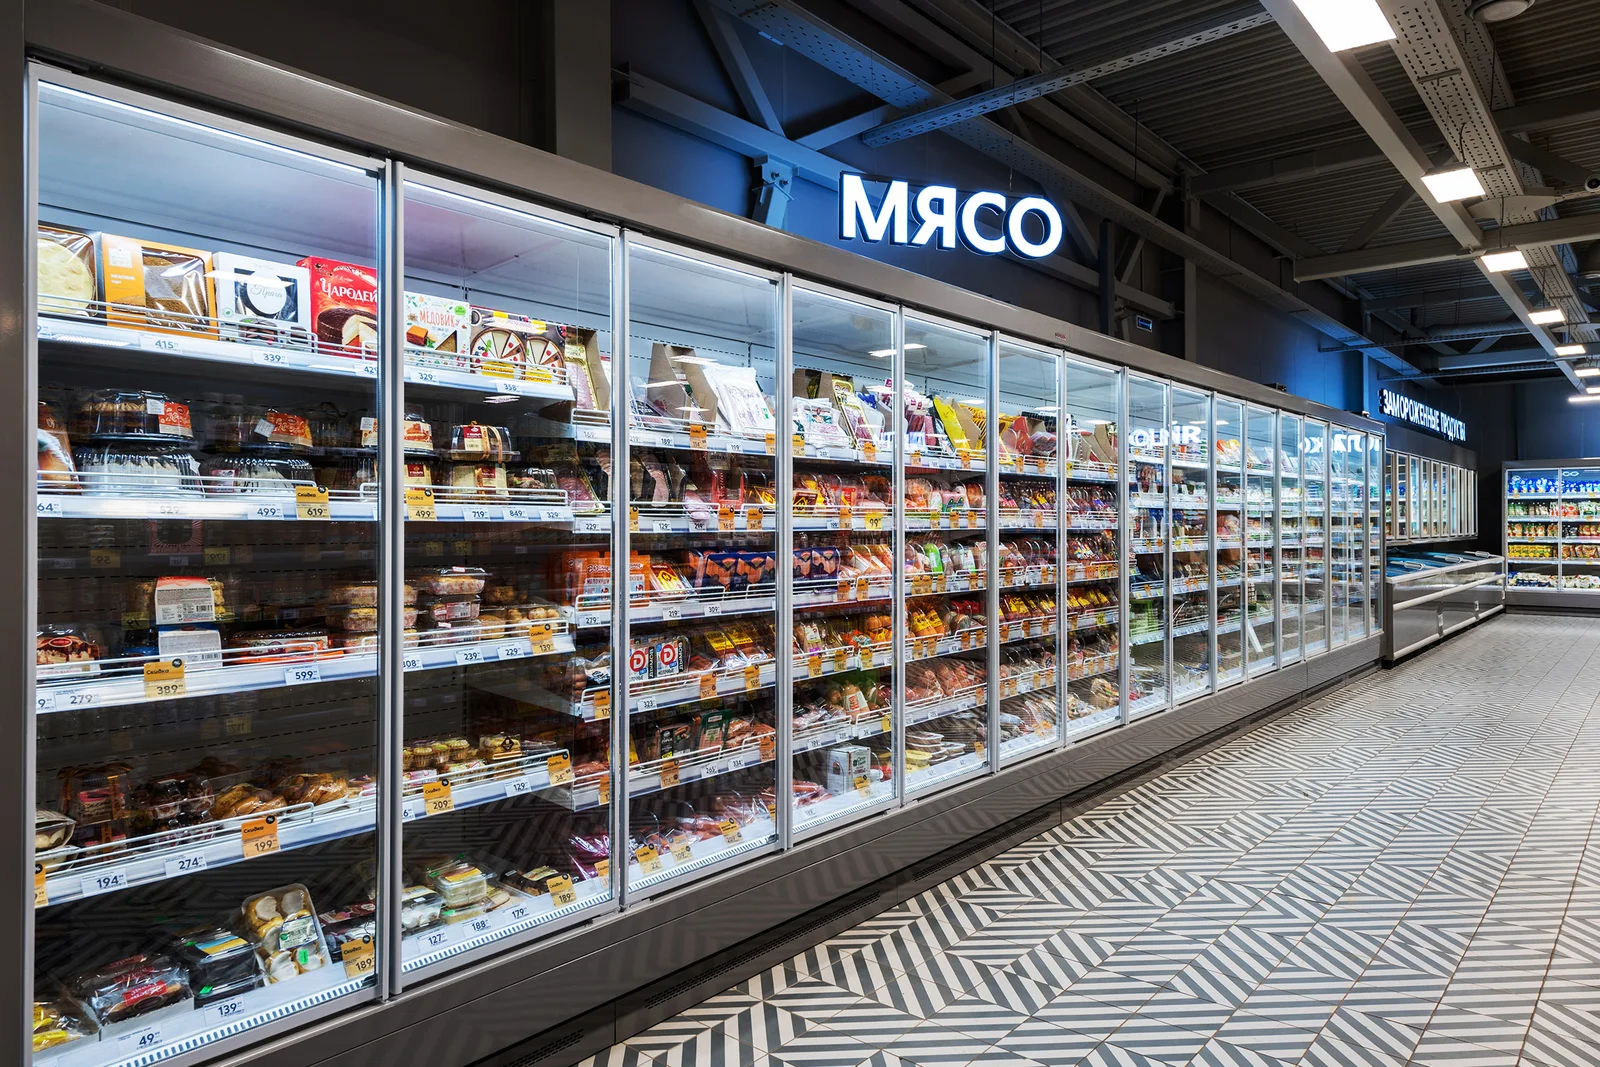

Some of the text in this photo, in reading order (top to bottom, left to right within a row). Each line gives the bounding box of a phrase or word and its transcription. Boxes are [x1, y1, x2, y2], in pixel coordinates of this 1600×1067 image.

[841, 172, 1063, 258] МЯСО
[419, 310, 456, 327] МЕДОВИК
[154, 340, 174, 350] 415
[263, 353, 282, 362] 339
[418, 372, 433, 381] 329
[504, 384, 517, 392] 358
[1382, 389, 1466, 442] ЗАМОРОЖЕННЫЕ ПРОДУКТЫ
[257, 508, 276, 516] 499
[307, 508, 323, 516] 619
[870, 518, 879, 527] 99
[464, 652, 478, 661] 239
[295, 670, 314, 680] 599
[157, 685, 178, 695] 389
[70, 695, 93, 705] 279
[513, 782, 526, 791] 129
[433, 800, 448, 810] 209
[243, 826, 264, 834] Скидка
[254, 840, 273, 852] 199
[178, 858, 198, 870] 274
[96, 877, 119, 889] 194
[558, 893, 571, 903] 189
[512, 908, 524, 919] 179
[472, 920, 486, 931] 188
[428, 934, 442, 945] 127
[343, 946, 362, 955] Скидка
[355, 958, 372, 971] 189
[218, 1002, 237, 1016] 139
[139, 1033, 155, 1046] 49
